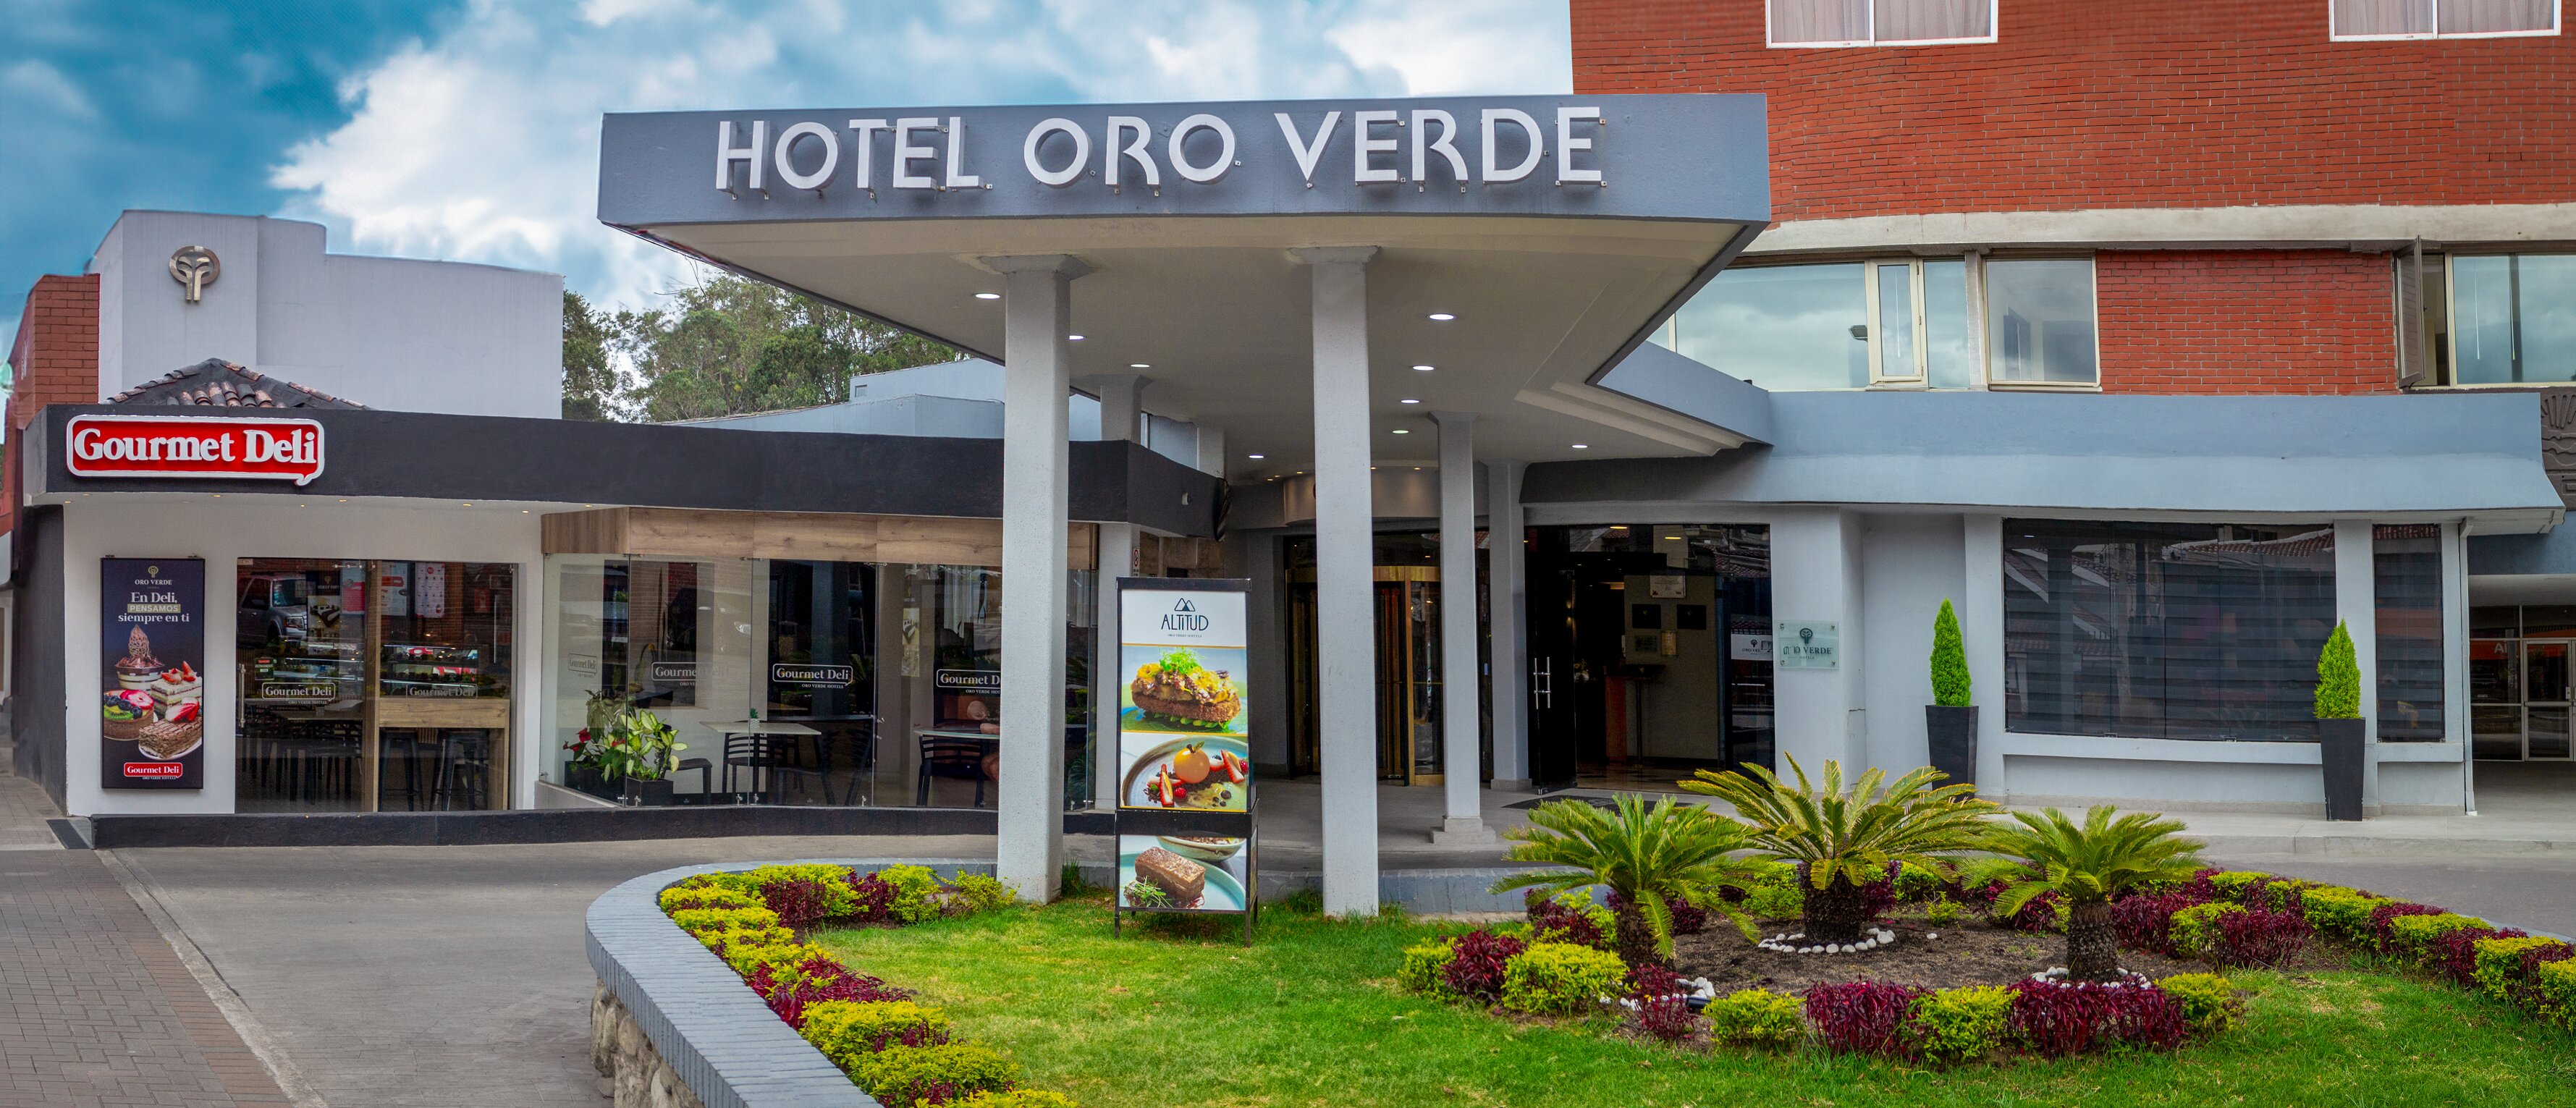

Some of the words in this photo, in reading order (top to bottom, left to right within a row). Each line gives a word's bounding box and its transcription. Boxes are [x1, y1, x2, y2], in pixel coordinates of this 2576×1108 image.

[716, 116, 986, 190] HOTEL
[1023, 113, 1236, 187] ORO
[1273, 106, 1604, 184] VERDE
[74, 428, 236, 462] Gourmet
[242, 428, 317, 464] Deli
[131, 592, 148, 603] En
[151, 592, 177, 604] Deli,
[130, 604, 179, 612] PENSAMOS
[118, 613, 163, 625] siempre
[181, 613, 190, 622] ti
[1161, 614, 1209, 631] ALTITUD
[1803, 646, 1832, 655] VERDE
[776, 667, 824, 679] Gourmet
[827, 669, 849, 680] Deli
[940, 673, 988, 685] Gourmet
[265, 686, 309, 696] Gourmet
[312, 687, 331, 696] Deli
[409, 687, 453, 696] Gourmet
[455, 688, 473, 697] Deli
[127, 765, 161, 774] Gourmet
[164, 765, 180, 774] Deli
